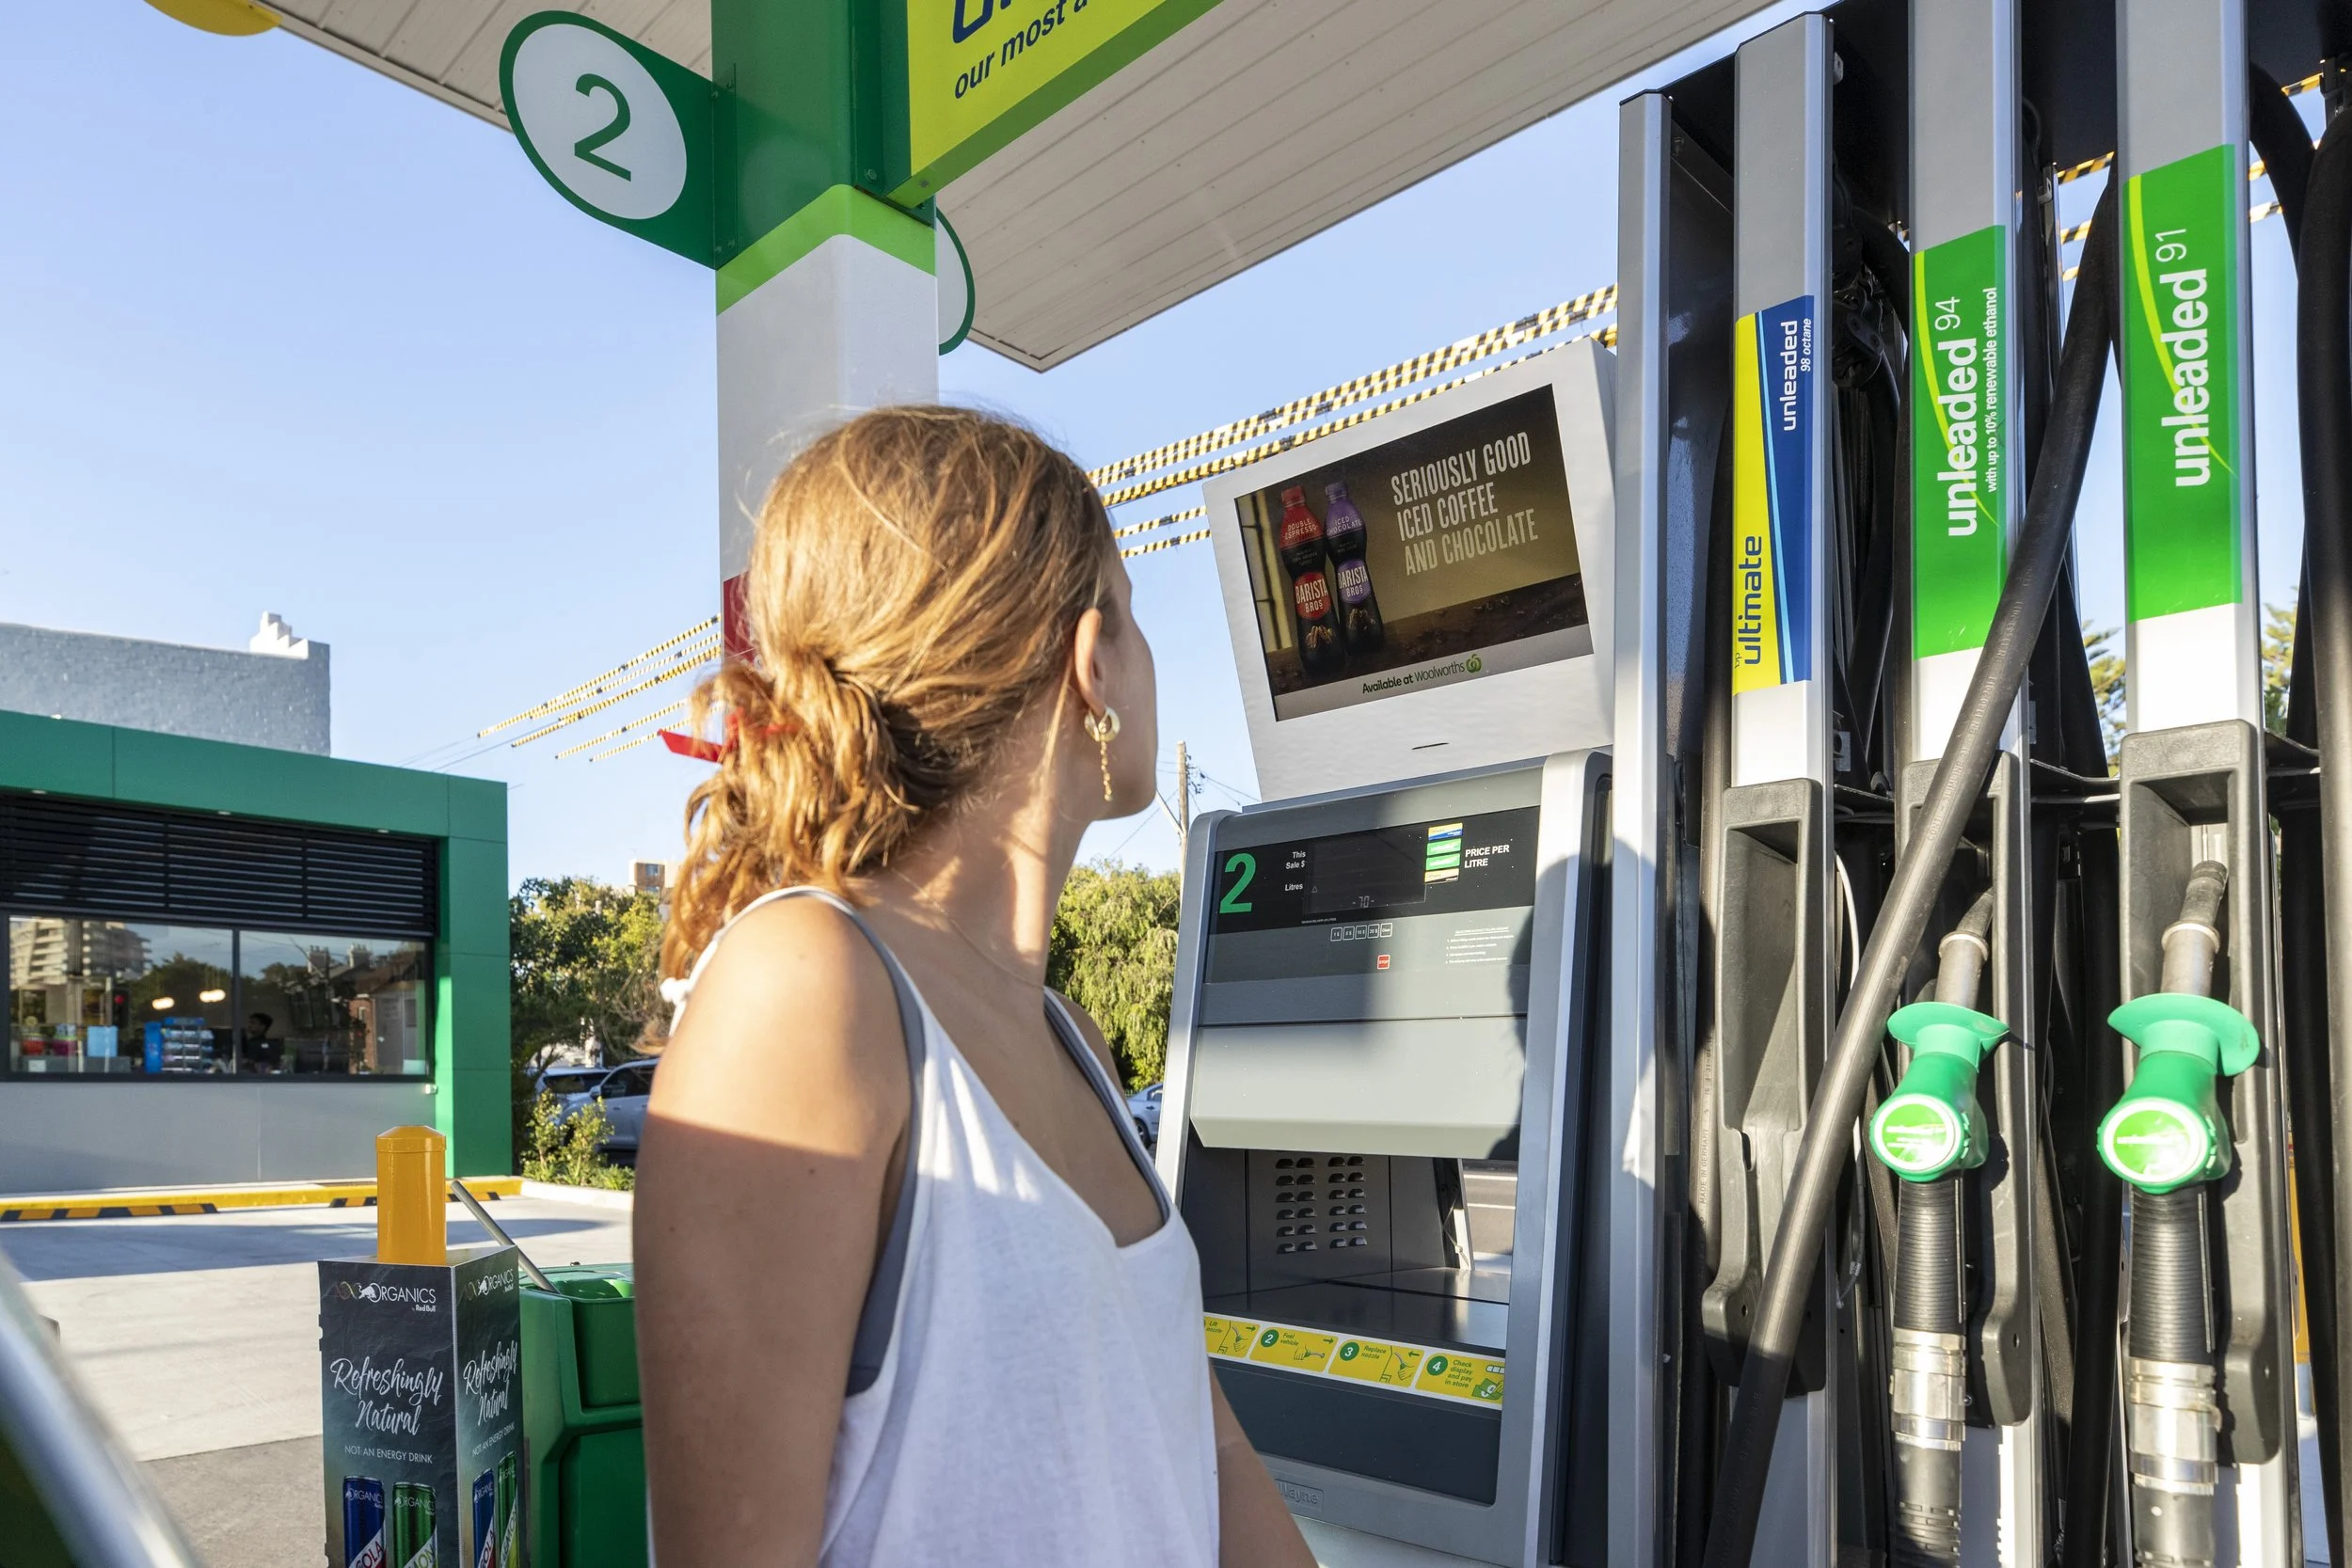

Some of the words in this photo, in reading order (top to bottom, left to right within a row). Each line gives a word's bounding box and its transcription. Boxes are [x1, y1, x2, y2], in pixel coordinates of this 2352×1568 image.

[954, 51, 995, 100] our
[1000, 0, 1066, 68] most
[574, 73, 632, 182] 2
[2154, 228, 2187, 263] 91
[1934, 295, 1961, 331] 94
[1982, 287, 1997, 338] ethanol
[1800, 318, 1812, 356] octane
[1780, 320, 1798, 432] unleaded
[1800, 357, 1811, 372] 98
[1982, 340, 1997, 410] renewable
[2159, 267, 2211, 487] unleaded
[1984, 411, 1997, 436] 10%
[1937, 337, 1978, 537] unleaded
[1986, 436, 1997, 450] to
[1391, 448, 1478, 506] SERIOUSLY
[1482, 431, 1532, 476] GOOD
[1988, 450, 2000, 466] up
[1985, 467, 1997, 493] with
[1396, 502, 1434, 542] ICED
[1437, 482, 1499, 529] COFFEE
[1284, 525, 1318, 540] ESPRESSO
[1287, 518, 1311, 532] DOUBLE
[1327, 520, 1363, 537] CHOCOLATE
[1405, 539, 1438, 576] AND
[1441, 508, 1539, 564] CHOCOLATE
[1337, 564, 1369, 590] BARISTA
[1295, 578, 1328, 605] BARISTA
[1738, 535, 1762, 665] ultimate
[1362, 677, 1403, 694] Available
[1403, 673, 1414, 686] at
[1414, 660, 1466, 683] Woolworths
[1292, 850, 1307, 859] This
[1465, 847, 1491, 858] PRICE
[1491, 844, 1510, 855] PER
[1285, 862, 1300, 870] Sale
[1300, 860, 1306, 868] $
[1464, 858, 1489, 869] LITRE
[1219, 852, 1257, 914] 2
[1284, 883, 1304, 892] Litres
[368, 1282, 437, 1304] ORGANICS
[415, 1304, 426, 1312] Red
[1264, 1334, 1274, 1344] 2
[1363, 1345, 1387, 1354] Replace
[1344, 1347, 1354, 1357] 3
[1432, 1361, 1441, 1371] 4
[1450, 1367, 1473, 1376] display
[1453, 1359, 1472, 1369] Check
[329, 1355, 443, 1406] Refreshingly
[1452, 1380, 1470, 1388] store
[1460, 1375, 1474, 1384] pay
[355, 1400, 422, 1436] Natural
[344, 1445, 361, 1455] NOT
[363, 1448, 374, 1457] AN
[376, 1449, 407, 1461] ENERGY
[408, 1452, 433, 1464] DRINK
